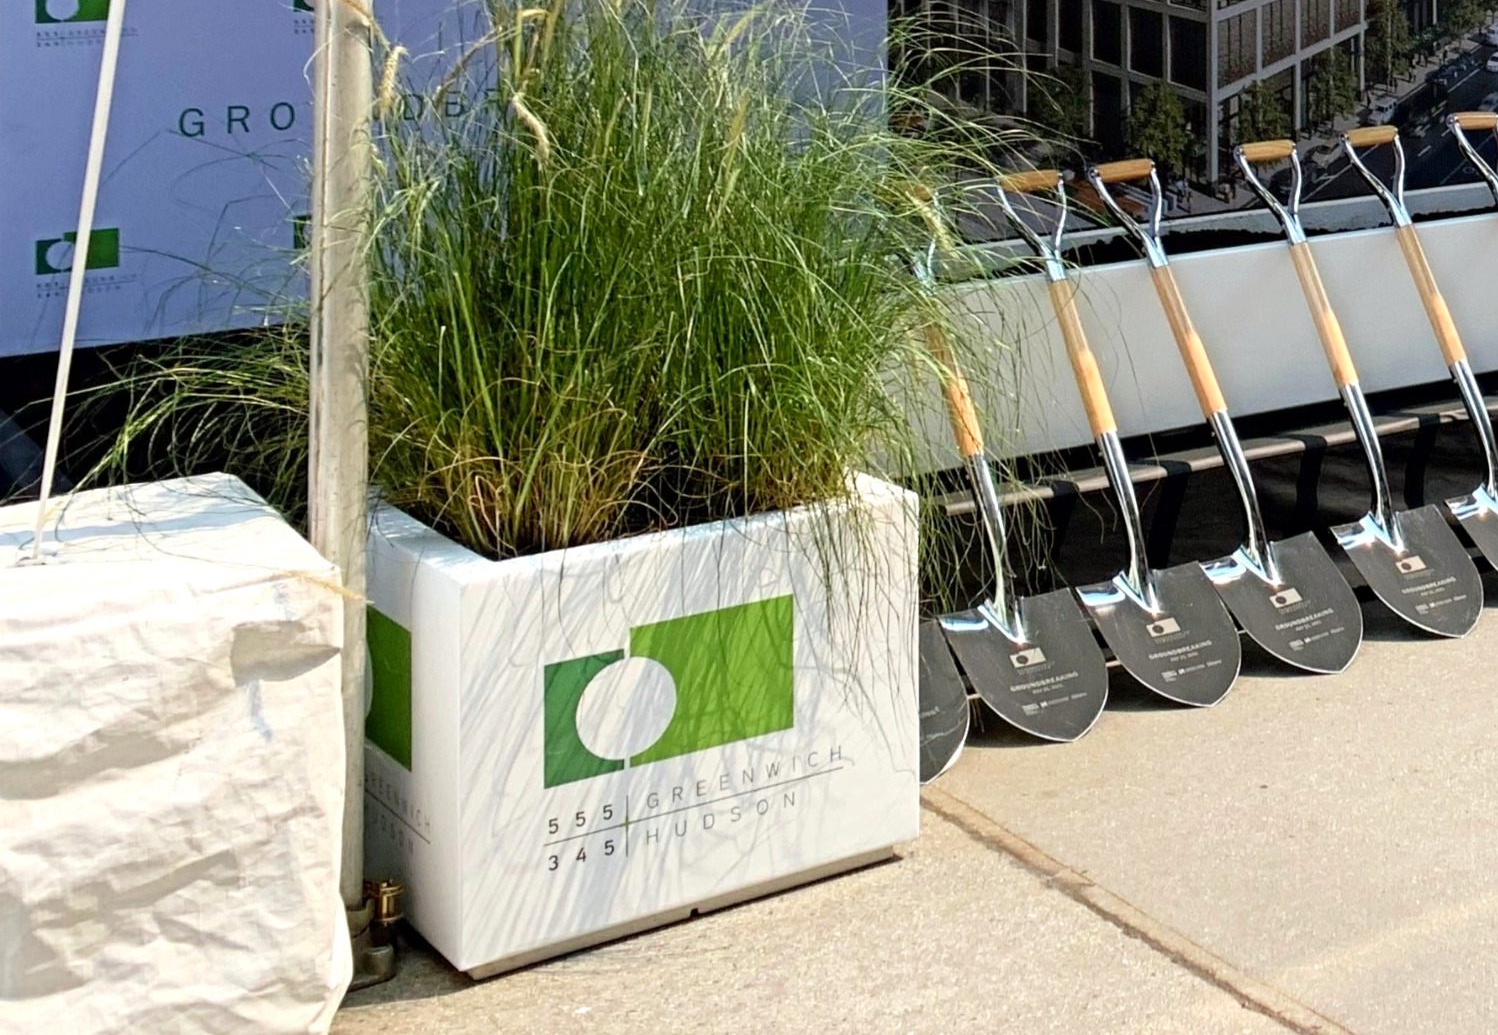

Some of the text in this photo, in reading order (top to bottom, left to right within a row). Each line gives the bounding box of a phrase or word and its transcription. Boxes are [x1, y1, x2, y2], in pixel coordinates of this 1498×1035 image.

[547, 791, 797, 872] 345 HUDSON
[548, 745, 842, 835] 555 GREENWICH
